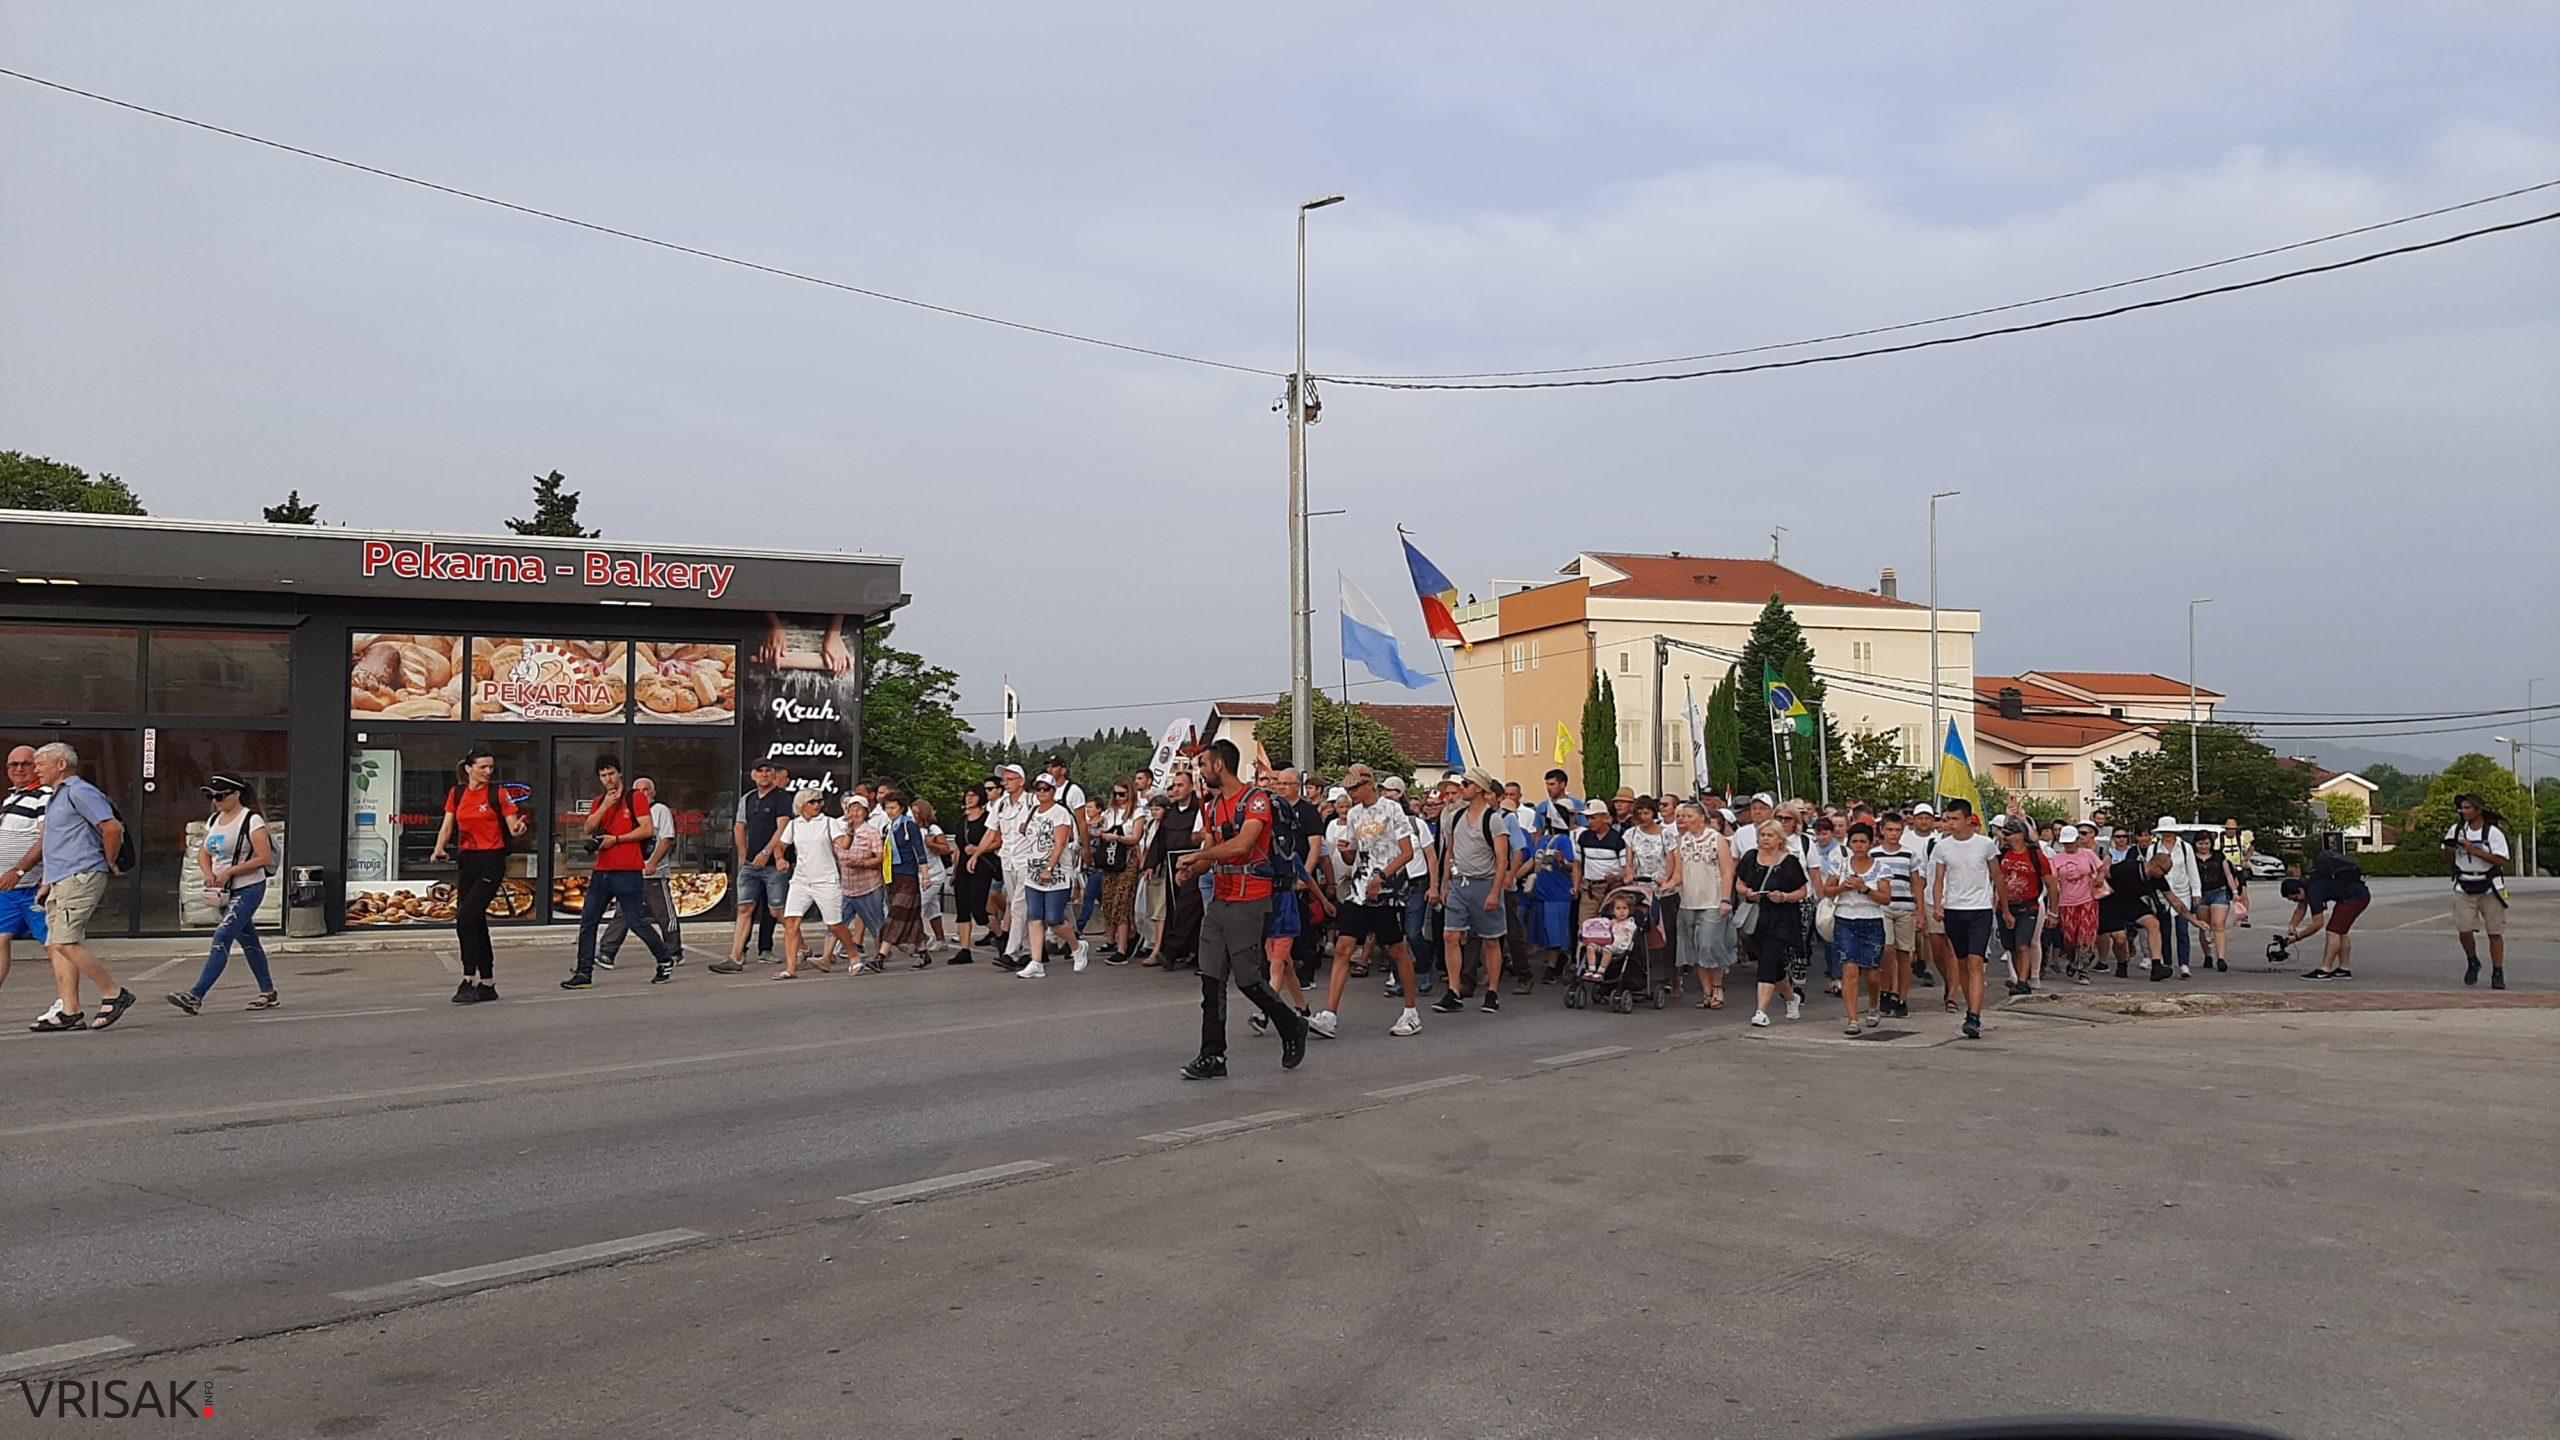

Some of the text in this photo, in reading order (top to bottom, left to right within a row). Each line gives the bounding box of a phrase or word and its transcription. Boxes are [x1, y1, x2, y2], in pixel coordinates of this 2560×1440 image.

[363, 541, 547, 583] Pekarna
[583, 551, 735, 598] Bakery
[482, 682, 613, 705] PEKARNA
[523, 704, 573, 719] Centar
[771, 697, 840, 722] Kruh,
[767, 739, 843, 760] peciva,
[785, 771, 838, 794] urek,
[388, 814, 429, 825] KRUH
